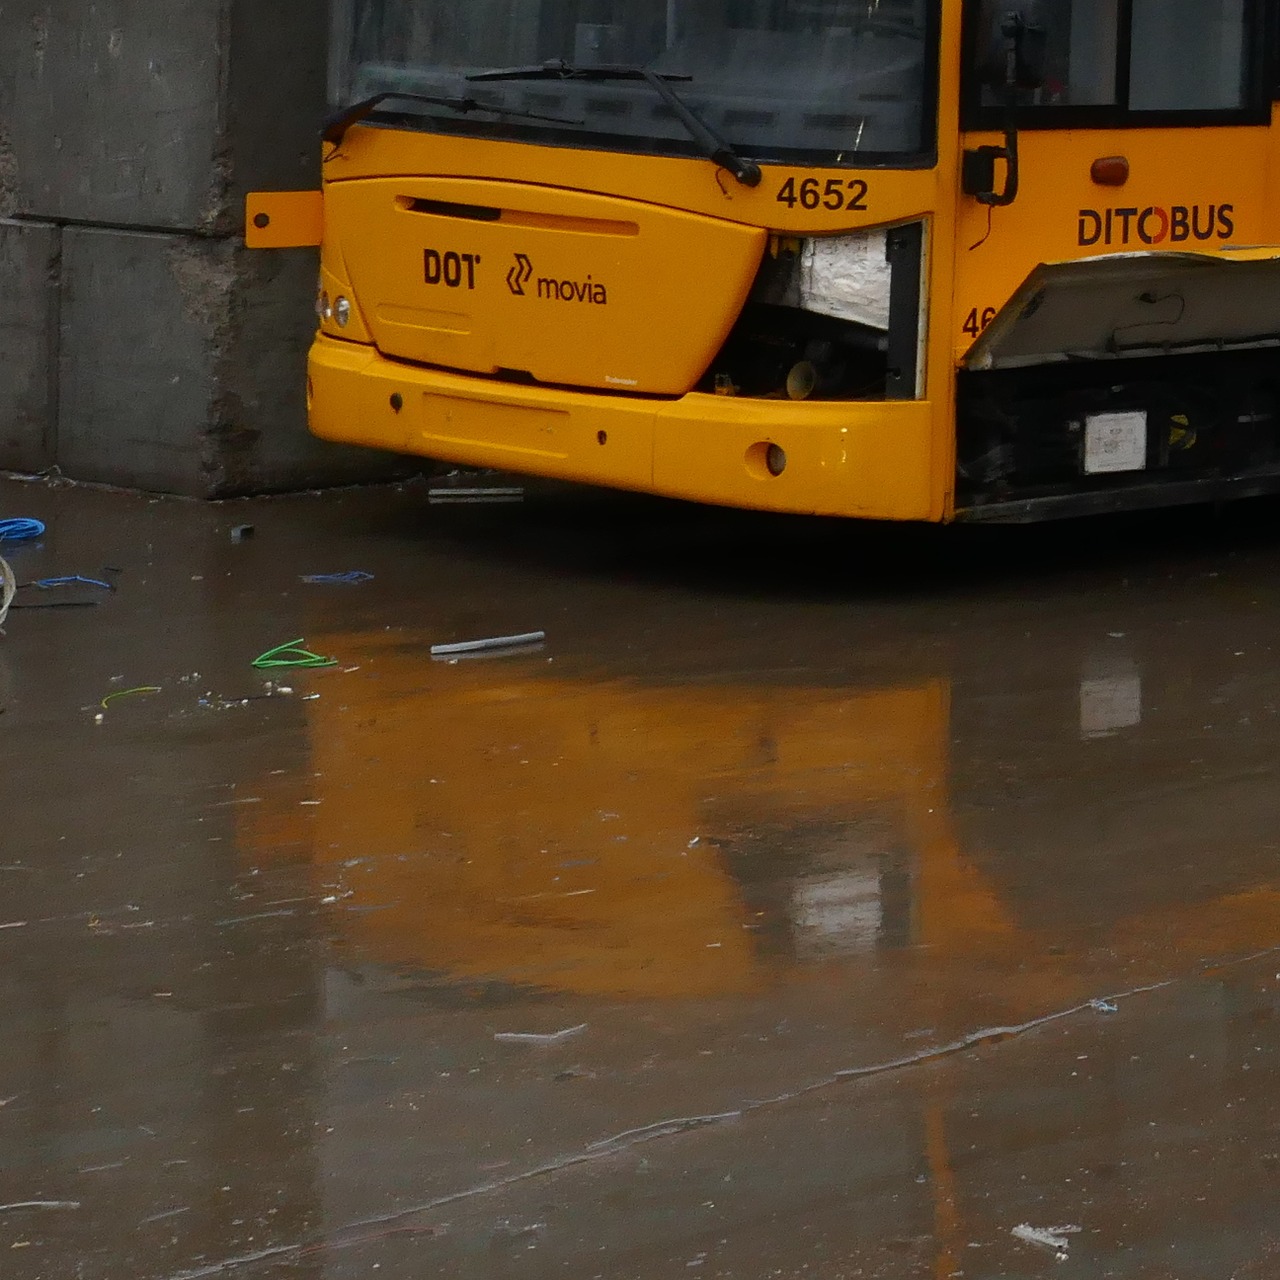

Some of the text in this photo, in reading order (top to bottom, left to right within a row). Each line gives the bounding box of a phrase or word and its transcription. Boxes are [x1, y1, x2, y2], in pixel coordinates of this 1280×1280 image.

[776, 177, 868, 211] 4652
[1078, 203, 1234, 247] DITOBUS
[423, 248, 481, 290] DOT
[537, 274, 607, 305] movia
